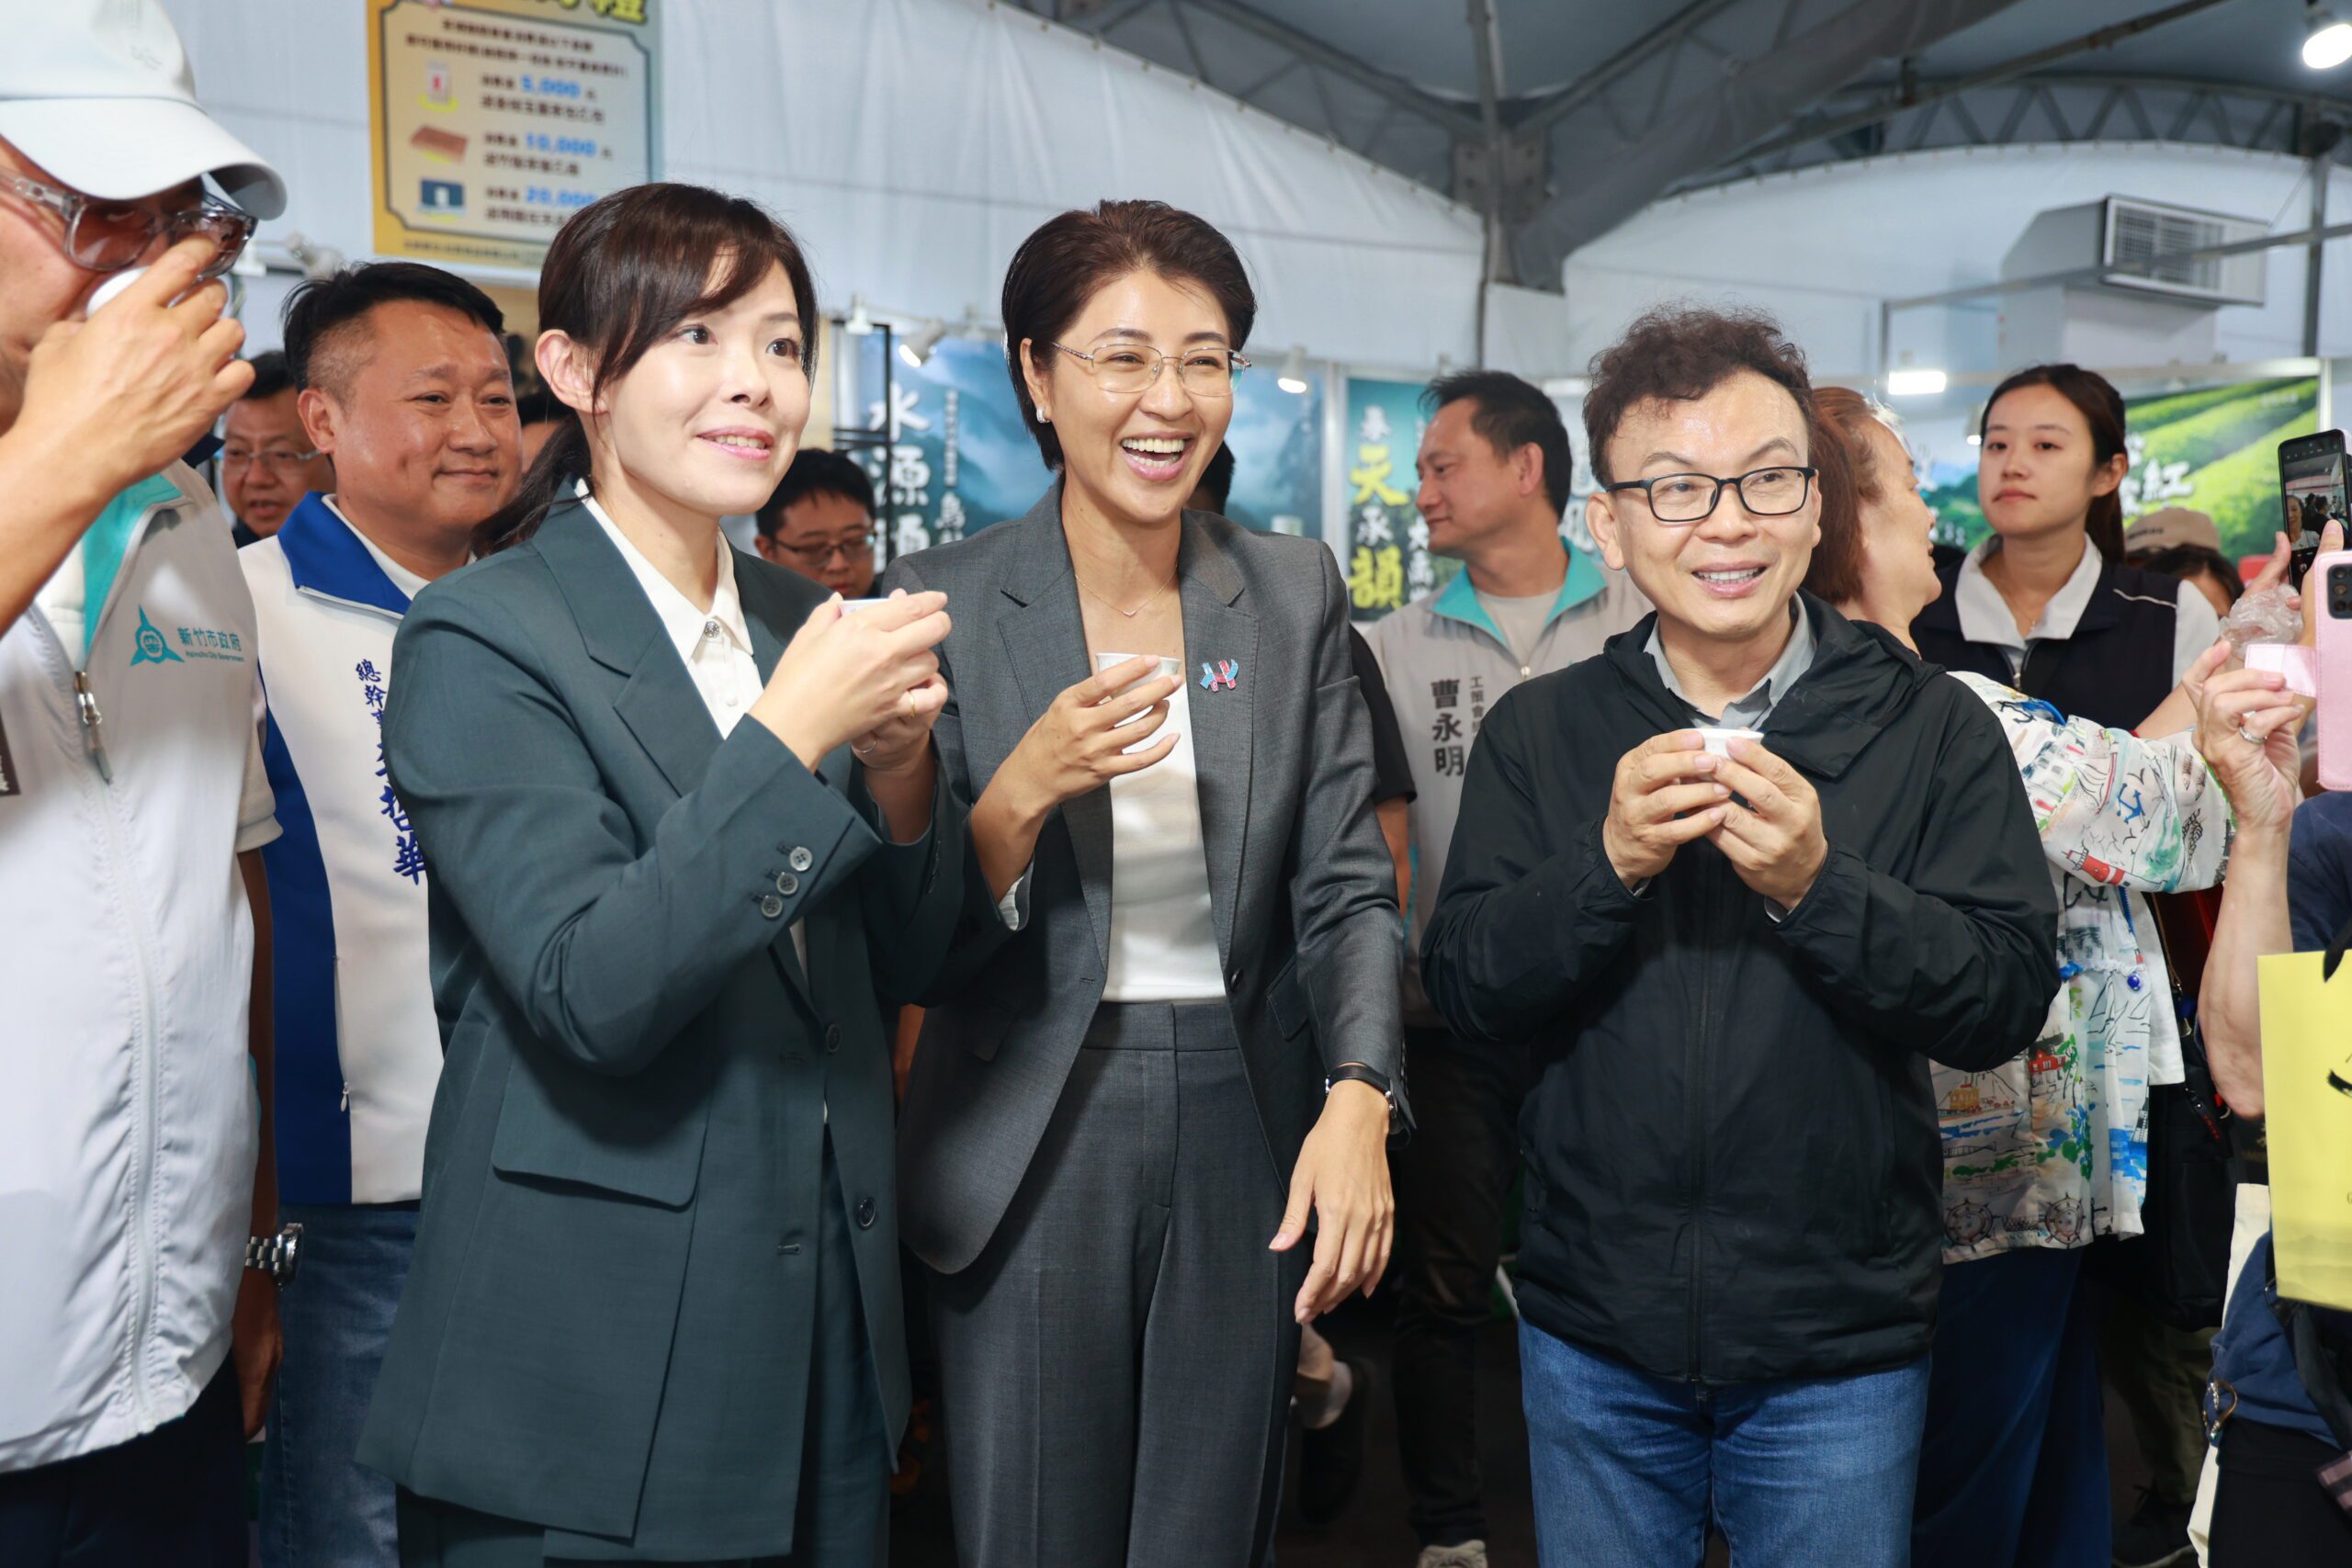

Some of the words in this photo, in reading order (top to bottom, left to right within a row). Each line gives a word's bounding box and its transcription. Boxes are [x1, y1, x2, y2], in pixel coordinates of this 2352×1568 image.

[177, 626, 242, 651] 新竹市政府
[1431, 679, 1464, 776] 曹永明
